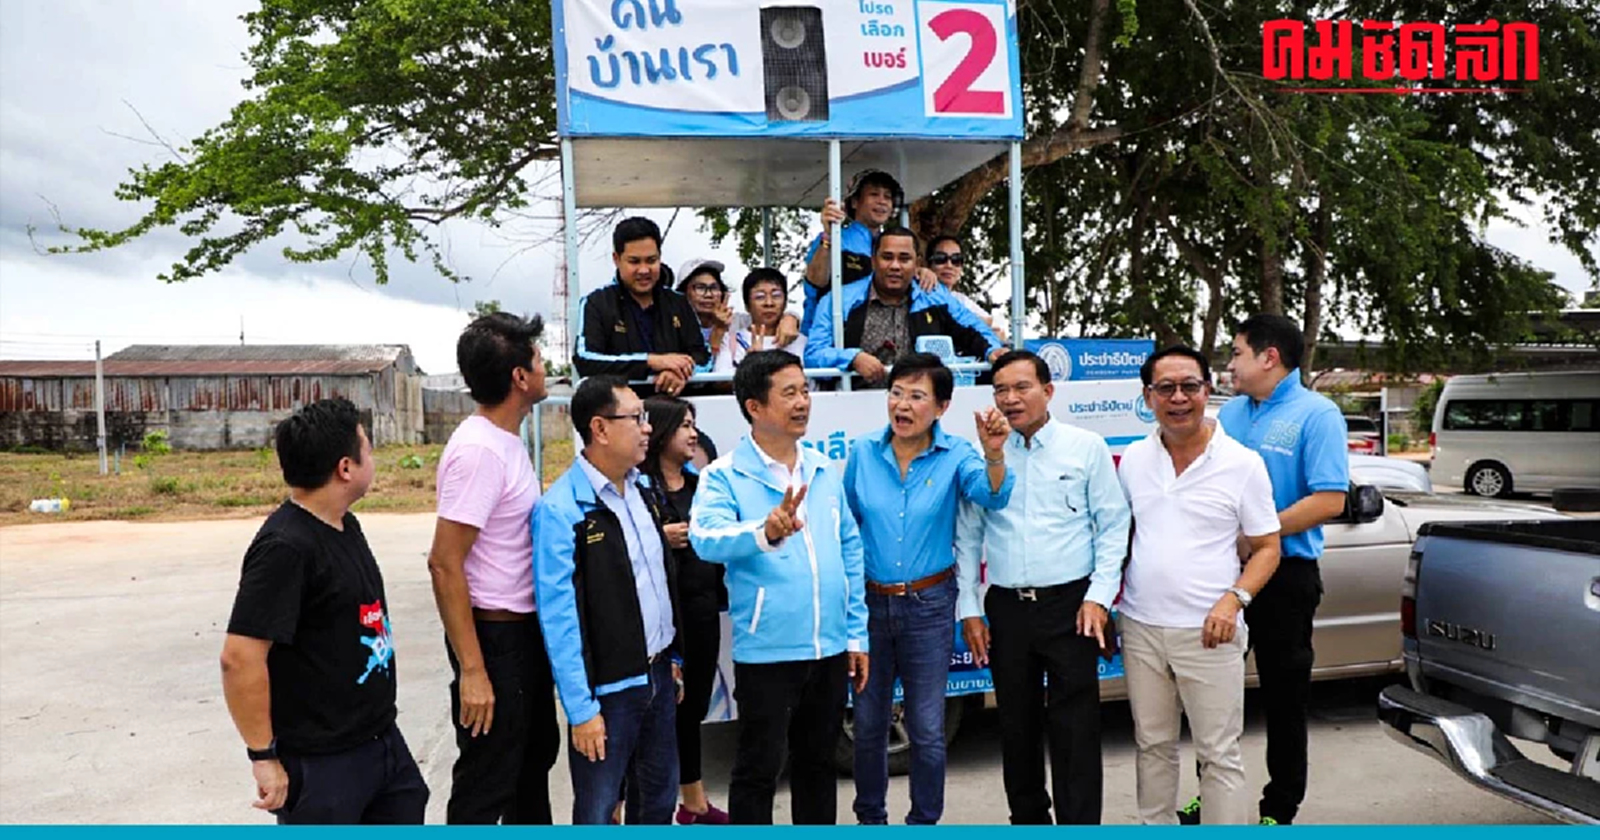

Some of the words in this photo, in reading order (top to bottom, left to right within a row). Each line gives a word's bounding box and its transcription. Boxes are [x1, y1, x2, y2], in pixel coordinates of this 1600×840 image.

[861, 20, 905, 37] เลือก
[587, 34, 739, 88] บ้านเรา
[864, 47, 906, 69] เบอร์
[928, 8, 1005, 114] 2
[1078, 351, 1147, 366] ประชาธิปัตย์
[1069, 399, 1133, 413] ประชาธิปัตย์
[1424, 617, 1497, 650] ISUZU
